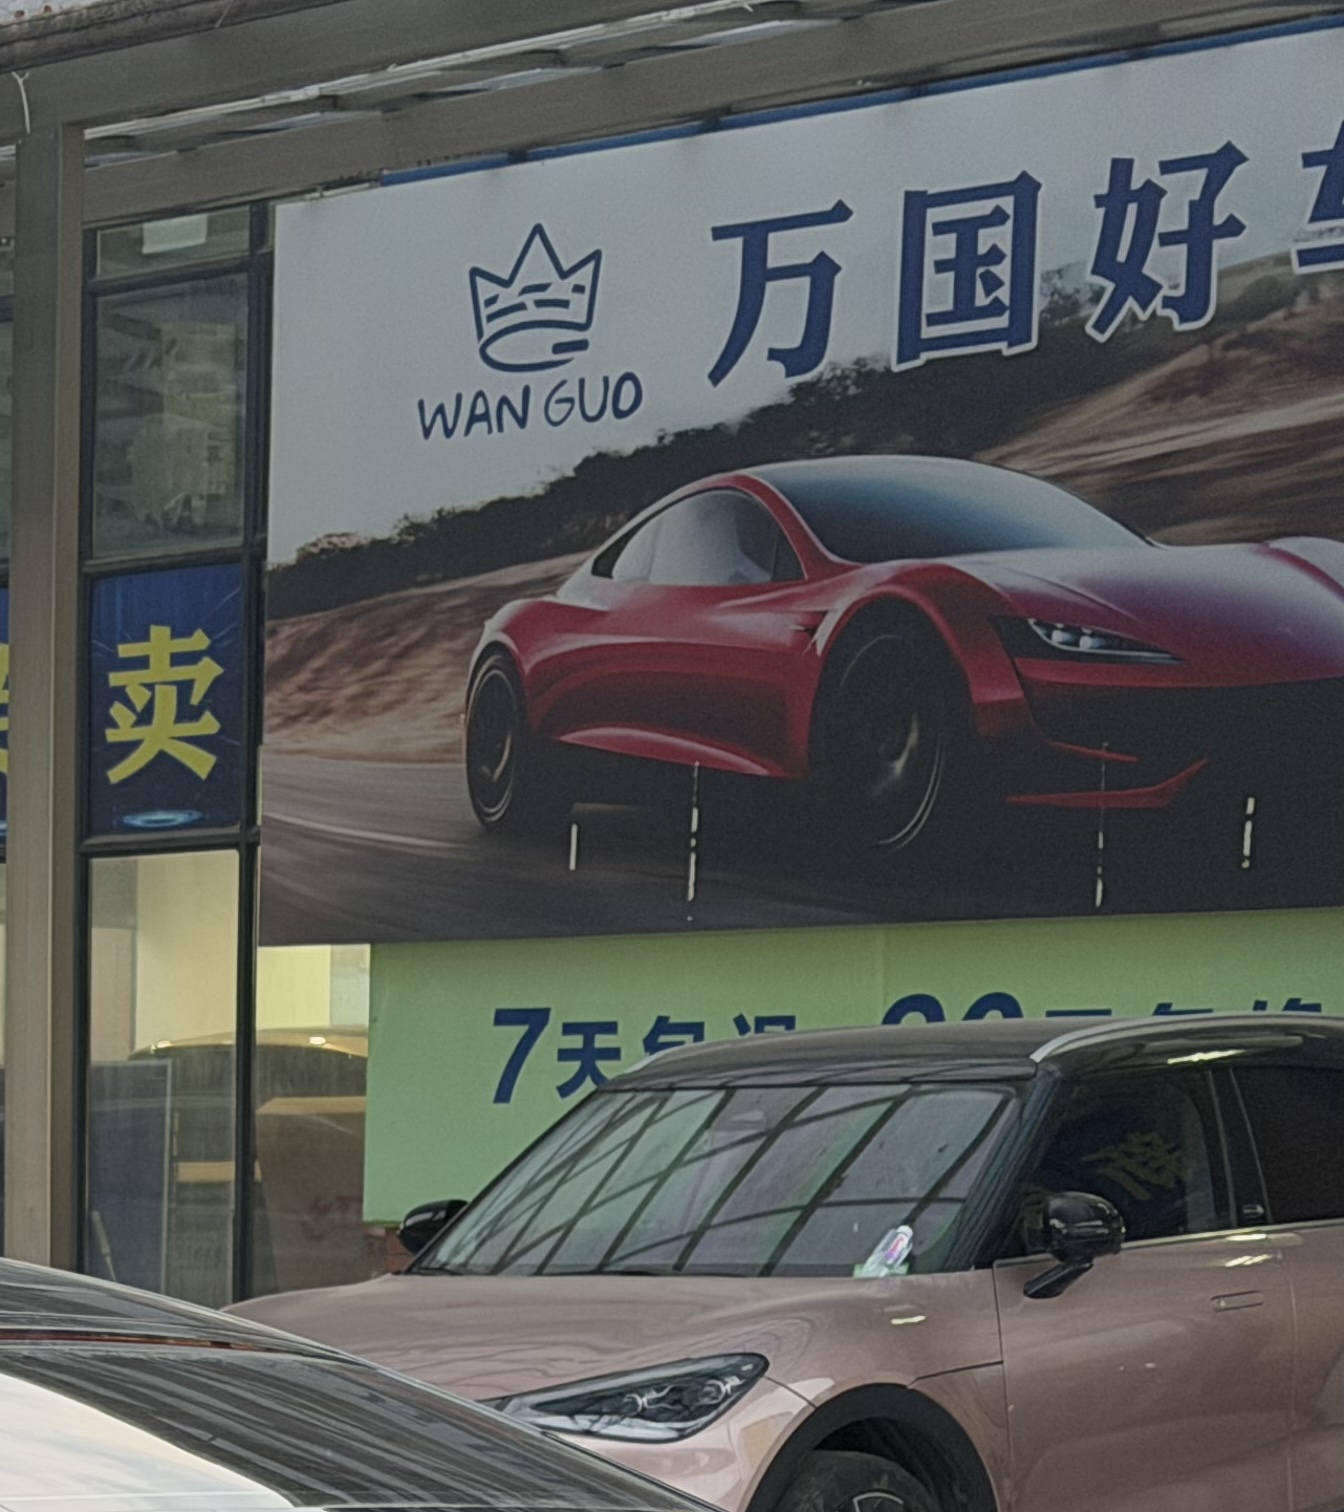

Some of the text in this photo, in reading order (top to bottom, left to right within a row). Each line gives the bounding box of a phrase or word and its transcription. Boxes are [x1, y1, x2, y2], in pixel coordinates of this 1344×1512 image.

[417, 371, 643, 441] WAN GUO
[493, 1007, 797, 1104] 7天
